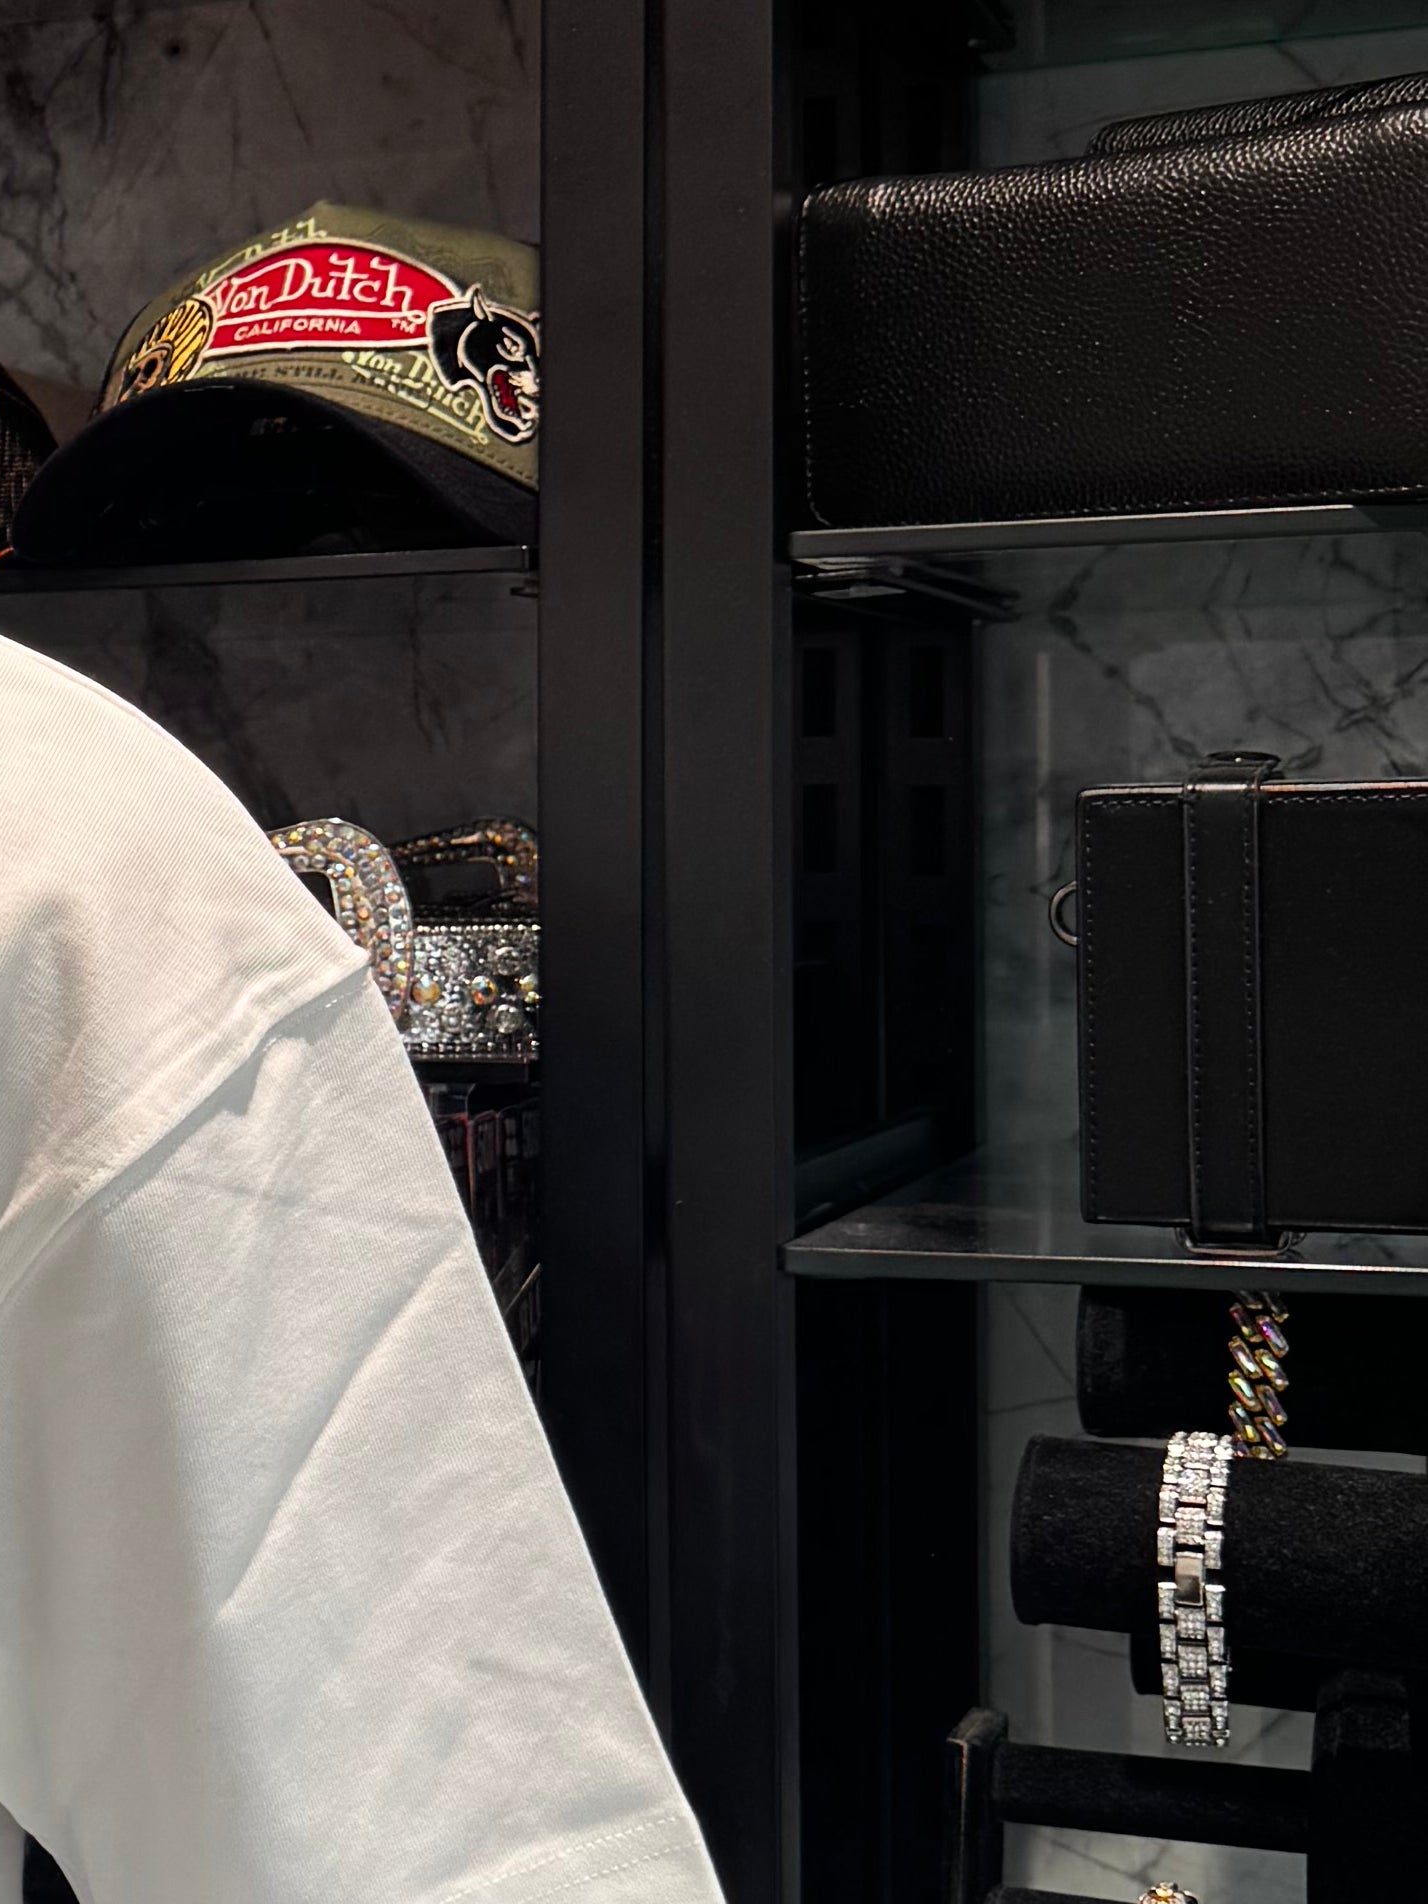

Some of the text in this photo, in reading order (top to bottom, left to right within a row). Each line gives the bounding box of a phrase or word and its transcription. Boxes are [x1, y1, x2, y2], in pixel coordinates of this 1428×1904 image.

[211, 280, 271, 317] Von
[272, 253, 413, 315] Dutch
[234, 318, 361, 342] CALIFORNIA
[391, 318, 416, 334] TM
